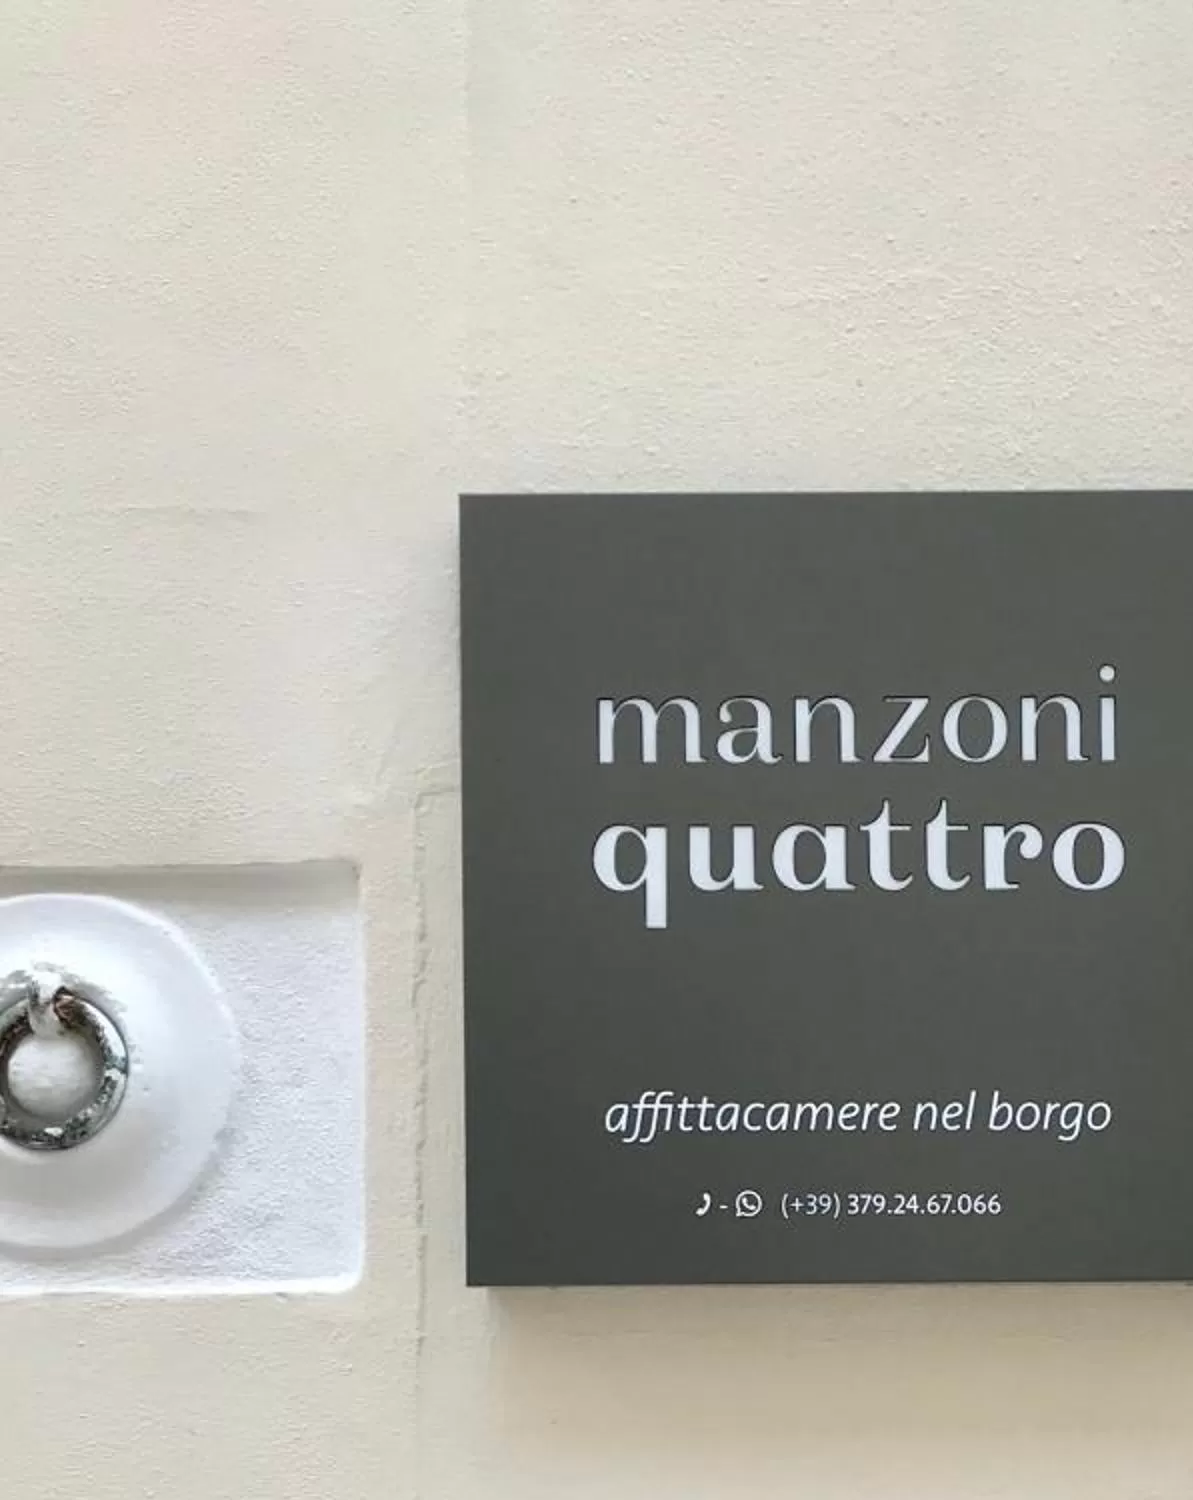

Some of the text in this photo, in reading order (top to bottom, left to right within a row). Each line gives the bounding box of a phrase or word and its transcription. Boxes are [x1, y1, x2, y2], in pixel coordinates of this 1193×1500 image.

[597, 664, 1118, 765] manzoni
[592, 799, 1126, 930] quattro
[604, 1089, 1112, 1143] affittacamere nel borgo
[781, 1192, 1002, 1220] (+39) 379.24.67.066
